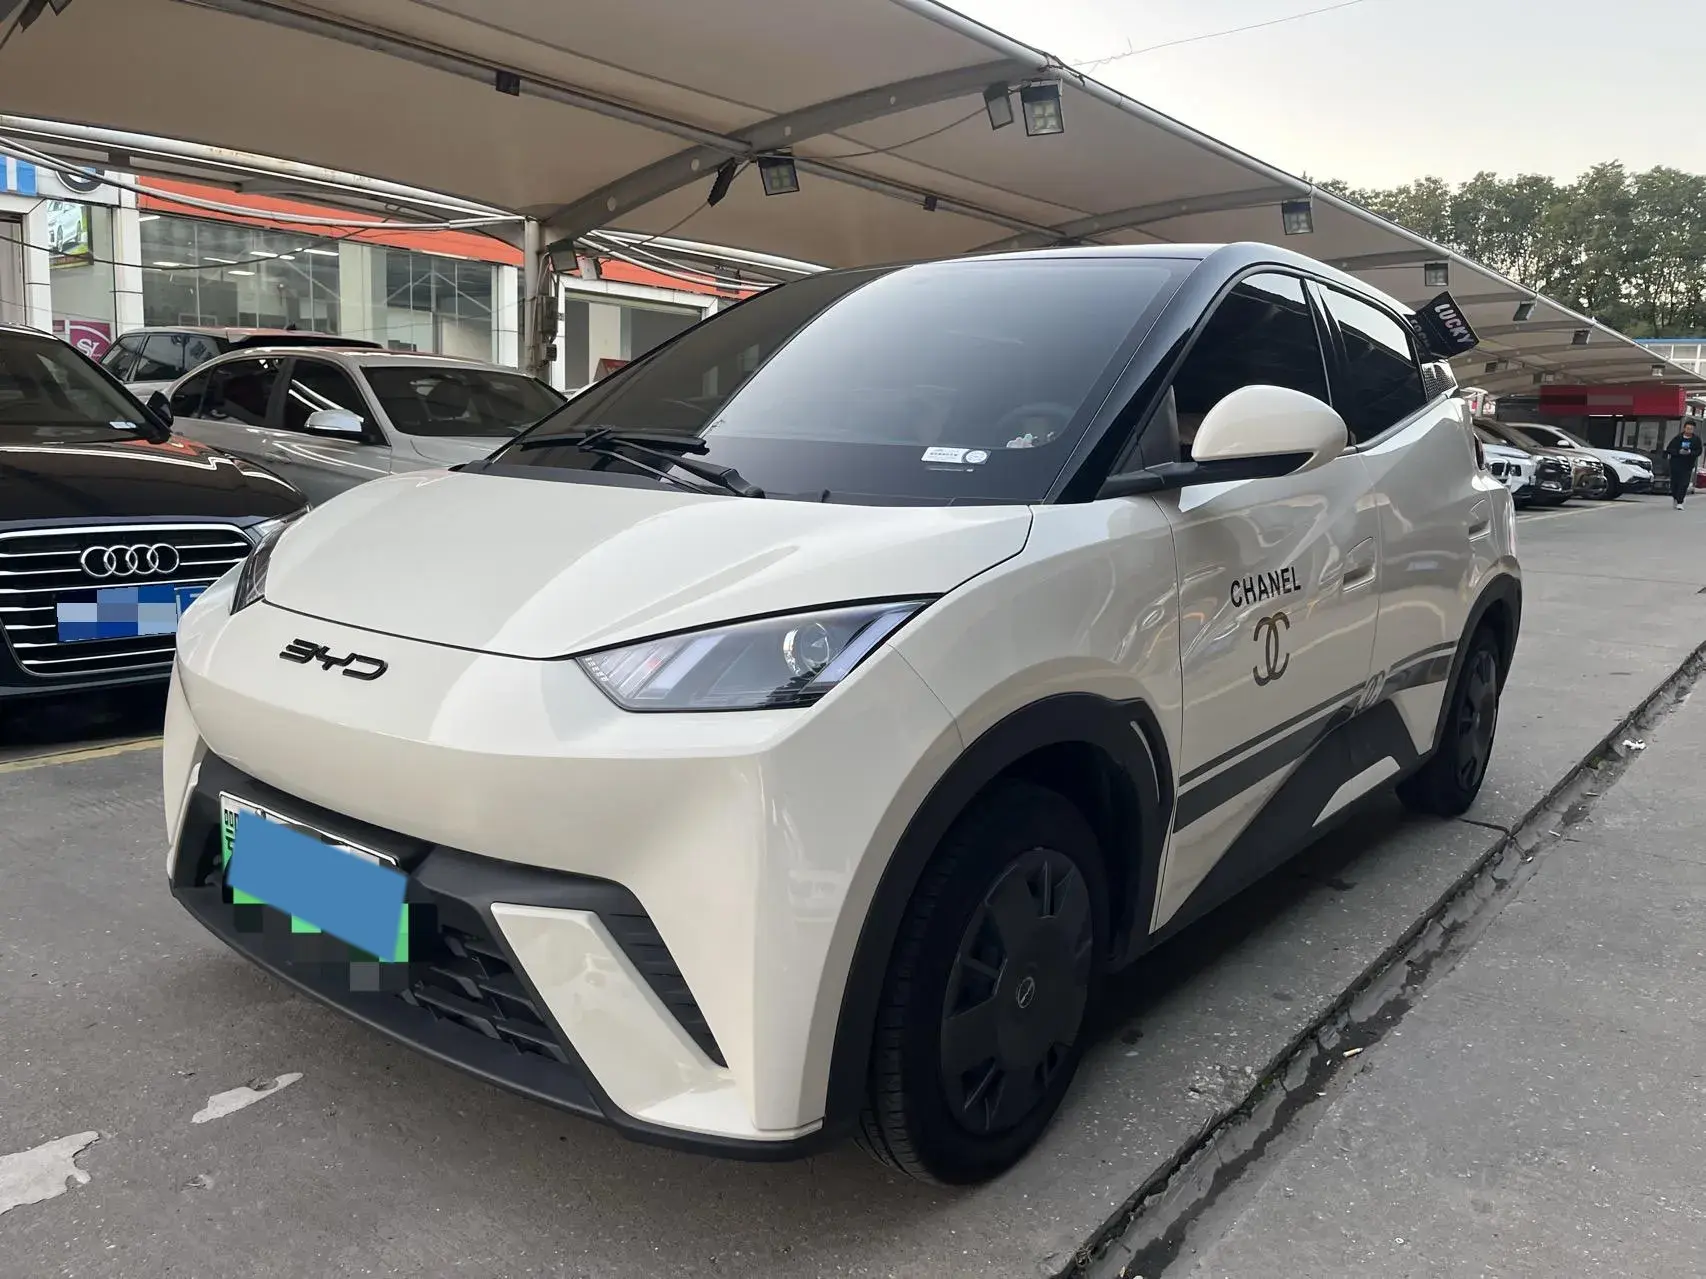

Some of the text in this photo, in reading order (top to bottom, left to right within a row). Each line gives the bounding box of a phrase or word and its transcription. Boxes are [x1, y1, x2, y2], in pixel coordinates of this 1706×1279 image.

[1434, 303, 1475, 343] LUCKY
[1230, 566, 1302, 608] CHANEL
[279, 638, 389, 681] BYD
